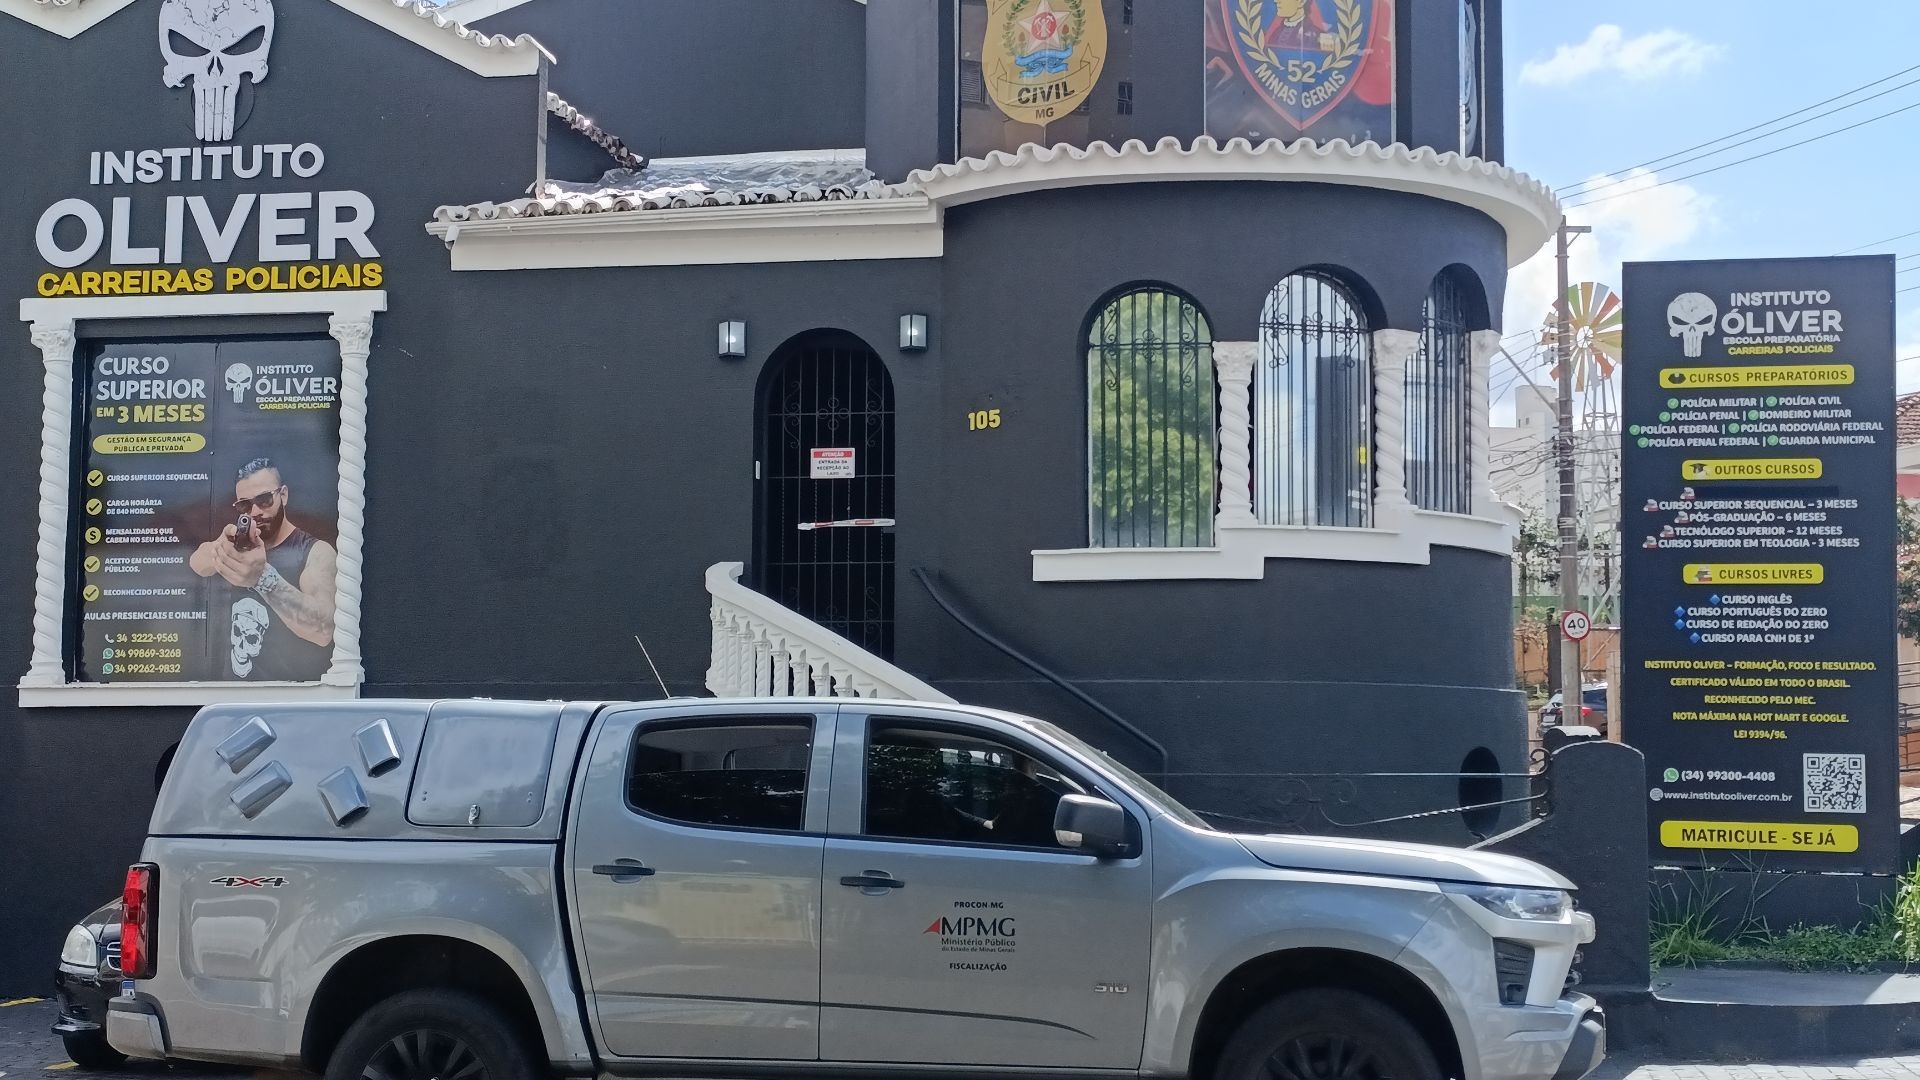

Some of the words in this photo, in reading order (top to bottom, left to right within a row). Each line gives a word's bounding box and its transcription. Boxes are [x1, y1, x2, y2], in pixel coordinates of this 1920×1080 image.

[1288, 60, 1316, 83] 52
[1255, 63, 1297, 105] MINAS
[1302, 71, 1345, 108] GERAIS
[1018, 81, 1074, 104] CIVIL
[1035, 107, 1054, 119] MG
[90, 142, 324, 184] INSTITUTO
[35, 190, 381, 268] OLIVER
[37, 268, 213, 296] CARREIRAS
[226, 263, 383, 291] POLICIAIS
[1730, 290, 1831, 306] INSTITUTO
[1721, 309, 1843, 334] ÓLIVER
[1723, 336, 1762, 345] ESCOLA
[1764, 334, 1840, 344] PREPARATÓRIA
[1728, 346, 1784, 355] CARREIRAS
[1786, 345, 1833, 353] POLICIAIS
[99, 356, 169, 375] CURSO
[257, 365, 313, 374] INSTITUTO
[1690, 372, 1739, 383] CURSOS
[1747, 370, 1847, 381] PREPARATÓRIOS
[96, 379, 206, 400] SUPERIOR
[255, 375, 337, 395] ÓLIVER
[1681, 397, 1717, 407] POLÍCIA
[1719, 398, 1756, 406] MILITAR
[1779, 396, 1816, 405] POLÍCIA
[1818, 396, 1842, 405] CIVIL
[96, 407, 114, 417] EM
[117, 407, 129, 423] 3
[134, 404, 205, 422] MESES
[1672, 410, 1708, 421] POLÍCIA
[1710, 411, 1739, 420] PENAL
[1760, 410, 1811, 419] BOMBEIRO
[1813, 409, 1851, 418] MILITAR
[968, 409, 1000, 431] 105
[1641, 424, 1677, 434] POLÍCIA
[1679, 425, 1719, 433] FEDERAL
[1741, 423, 1777, 432] POLÍCIA
[1780, 422, 1840, 432] RODOVIÁRIA
[1842, 422, 1883, 431] FEDERAL
[1649, 437, 1685, 447] POLÍCIA
[1687, 438, 1717, 446] PENAL
[1719, 437, 1759, 446] FEDERAL
[1779, 436, 1819, 445] GUARDA
[1822, 435, 1875, 444] MUNICIPAL
[1715, 465, 1762, 475] OUTROS
[1766, 465, 1815, 474] CURSOS
[1659, 501, 1691, 509] CURSO
[1694, 501, 1742, 509] SUPERIOR
[1744, 500, 1805, 510] SEQUENCIAL
[1817, 500, 1823, 508] 3
[1825, 500, 1857, 508] MESES
[1690, 511, 1774, 524] PÓS-GRADUAÇÃO
[1786, 513, 1791, 521] 6
[1794, 513, 1826, 521] MESES
[1674, 525, 1734, 536] TECNÓLOGO
[1737, 527, 1785, 535] SUPERIOR
[1796, 527, 1807, 535] 12
[1810, 527, 1842, 535] MESES
[1659, 539, 1691, 548] CURSO
[1693, 539, 1741, 547] SUPERIOR
[1743, 539, 1758, 547] EM
[1760, 539, 1809, 547] TEOLOGIA
[1819, 539, 1824, 547] 3
[1827, 539, 1859, 547] MESES
[1719, 570, 1768, 579] CURSOS
[1772, 570, 1812, 579] LIVRES
[1722, 595, 1755, 604] CURSO
[1757, 593, 1792, 604] INGLÊS
[112, 612, 167, 620] PRESENCIAIS
[1688, 608, 1721, 616] CURSO
[1723, 606, 1782, 616] PORTUGUÊS
[1784, 608, 1799, 616] DO
[1801, 608, 1827, 616] ZERO
[1568, 618, 1585, 629] 40
[1686, 620, 1719, 629] CURSO
[1722, 621, 1734, 629] DE
[1737, 619, 1783, 631] REDAÇÃO
[1786, 620, 1799, 629] DO
[1801, 620, 1828, 629] ZERO
[117, 634, 127, 642] 34
[131, 633, 178, 643] 3222-9563
[1702, 634, 1734, 643] CURSO
[1737, 634, 1762, 643] PARA
[1765, 634, 1786, 643] CNH
[1789, 634, 1801, 642] DE
[115, 649, 126, 658] 34
[128, 649, 181, 658] 99869-3268
[114, 664, 125, 673] 34
[128, 664, 180, 673] 99262-9832
[1645, 661, 1691, 669] INSTITUTO
[1693, 661, 1725, 669] OLIVER
[1789, 662, 1813, 670] FOCO
[1822, 662, 1876, 670] RESULTADO.
[1671, 678, 1727, 686] CERTIFICADO
[1729, 677, 1762, 686] VÁLIDO
[1764, 679, 1778, 687] EM
[1779, 679, 1805, 687] TODO
[1817, 679, 1850, 687] BRASIL.
[1705, 696, 1768, 704] RECONHECIDO
[1770, 696, 1792, 704] PELO
[1795, 696, 1816, 704] MEC.
[1673, 712, 1697, 720] NOTA
[1699, 711, 1736, 721] MÁXIMA
[1738, 713, 1752, 721] NA
[1754, 713, 1773, 721] HOT
[1775, 713, 1800, 721] MART
[1810, 714, 1848, 722] GOOGLE.
[1734, 730, 1747, 738] LEI
[1681, 770, 1704, 781] (34)
[1707, 771, 1775, 781] 99300-4408
[1664, 791, 1792, 802] www.institutooliver.com.br
[1682, 829, 1777, 844] MATRICULE
[1793, 832, 1812, 845] SE
[1817, 829, 1835, 845] JÁ
[942, 917, 1015, 936] MPMG
[942, 938, 982, 946] Ministério
[950, 963, 1007, 971] FISCALIZAÇÃO
